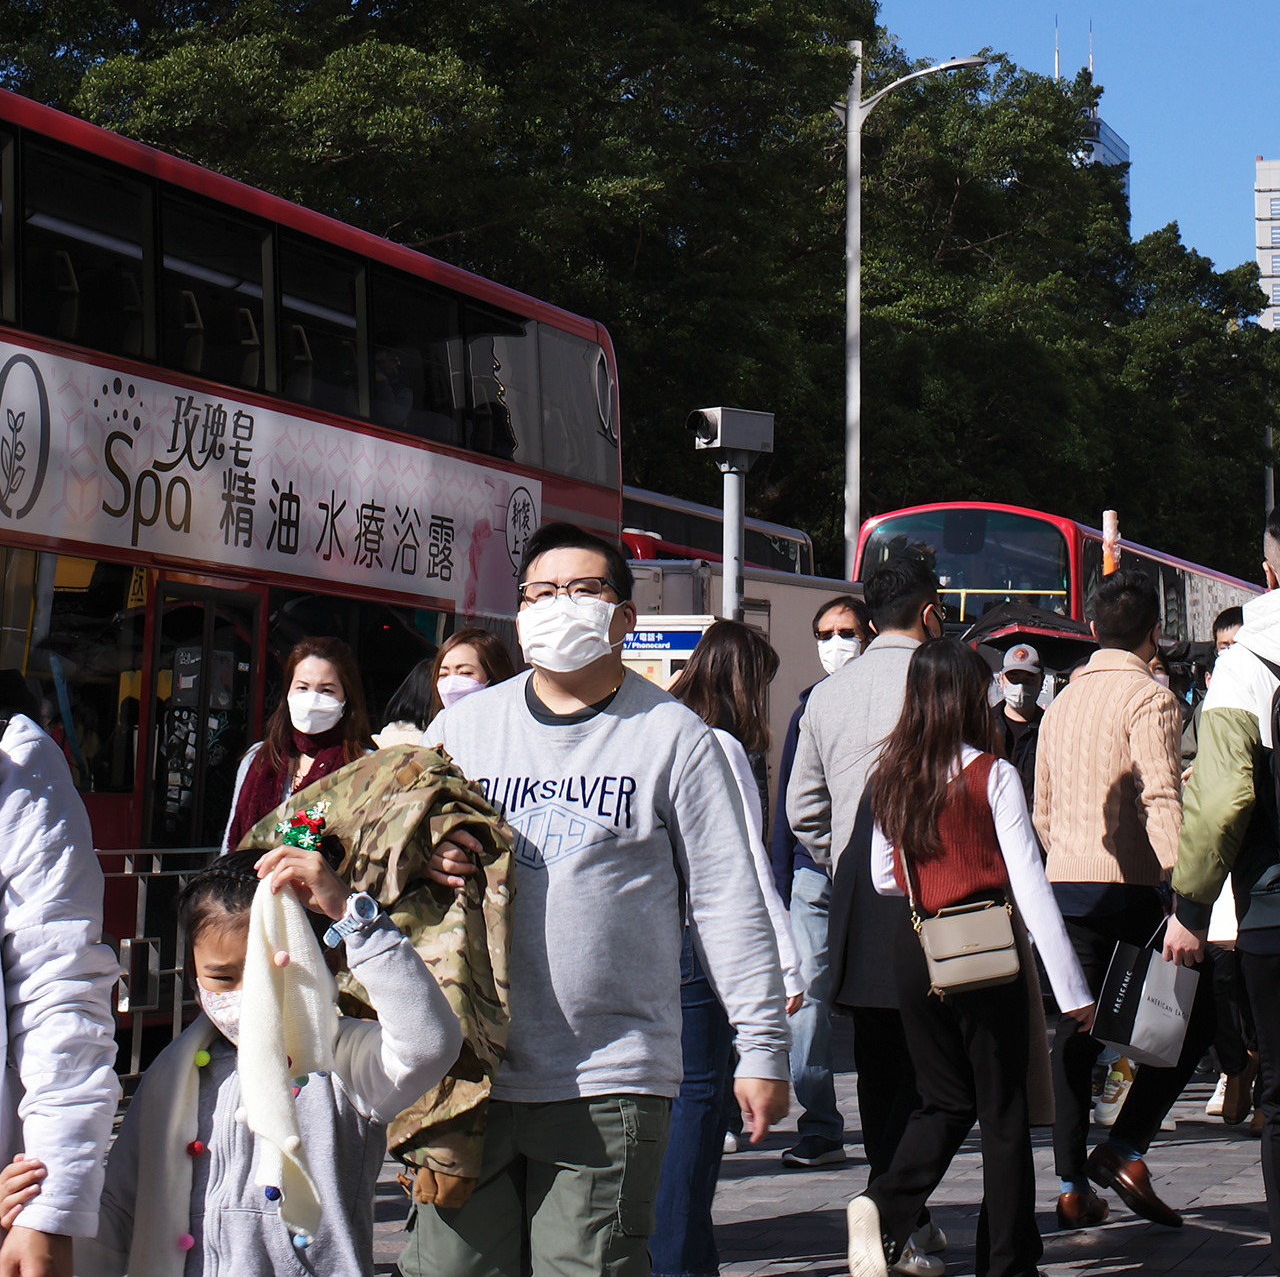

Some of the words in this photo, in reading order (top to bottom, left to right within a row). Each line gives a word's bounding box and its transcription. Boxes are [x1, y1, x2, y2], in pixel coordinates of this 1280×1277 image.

[102, 430, 192, 546] Spa
[152, 395, 254, 471] 玫瑰皂
[219, 467, 455, 582] 精油水療浴露
